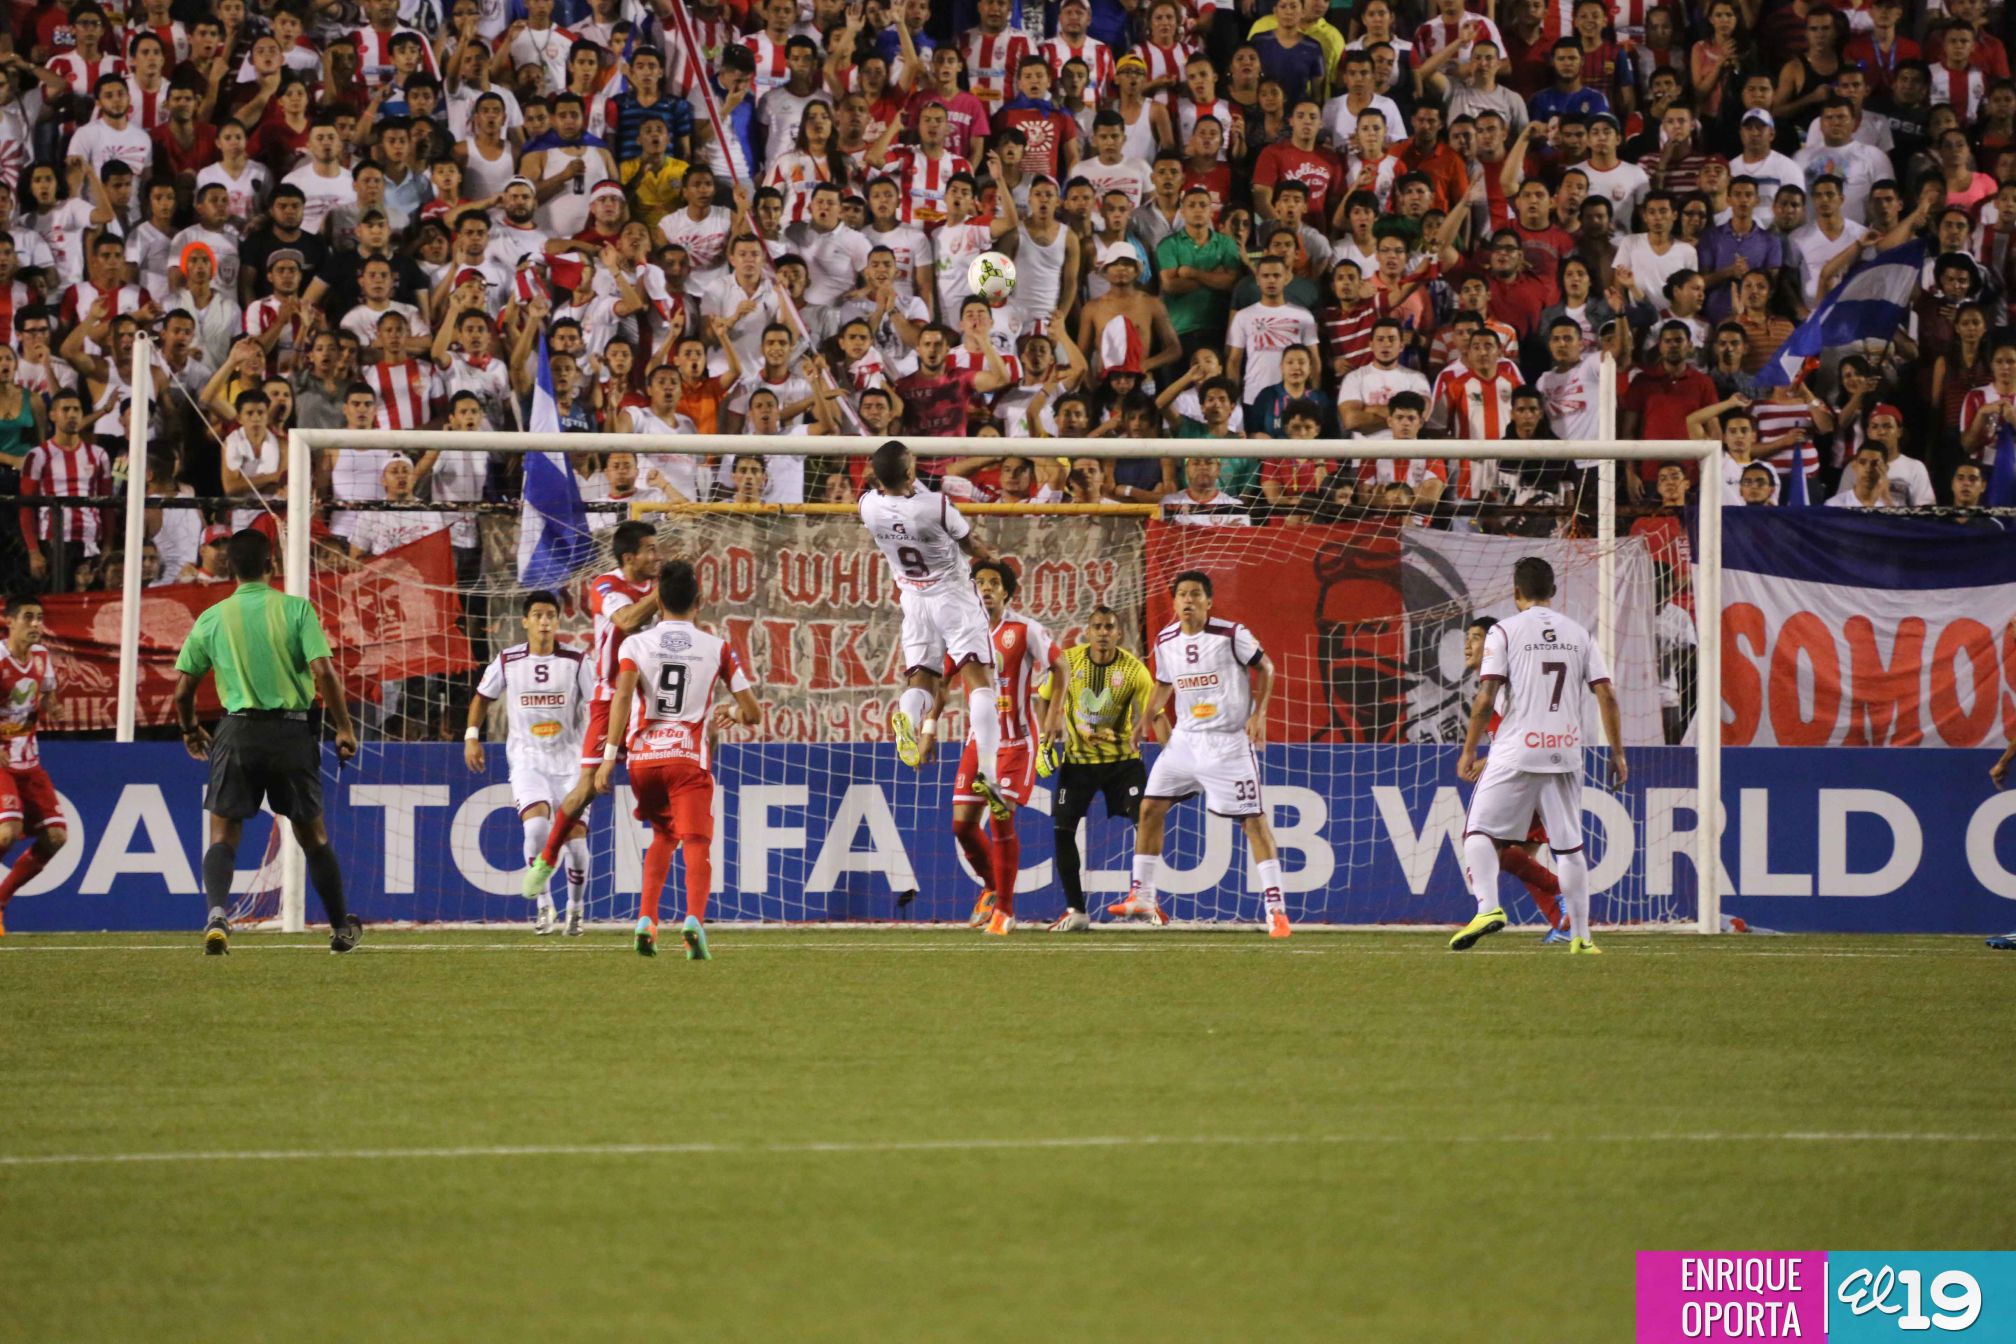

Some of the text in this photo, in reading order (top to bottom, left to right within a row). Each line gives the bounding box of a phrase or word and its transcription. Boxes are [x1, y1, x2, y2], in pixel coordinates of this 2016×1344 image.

[897, 546, 929, 578] 9
[1186, 644, 1199, 664] S
[1524, 643, 1578, 652] GATORADE
[534, 664, 549, 683] S
[1177, 673, 1219, 689] BIMBO
[656, 662, 690, 716] 9
[1542, 662, 1567, 712] 7
[520, 694, 565, 706] BIMBO
[1524, 731, 1574, 749] Claro
[1234, 779, 1257, 801] 33
[350, 784, 566, 895] TO
[1371, 786, 1924, 897] WORLD
